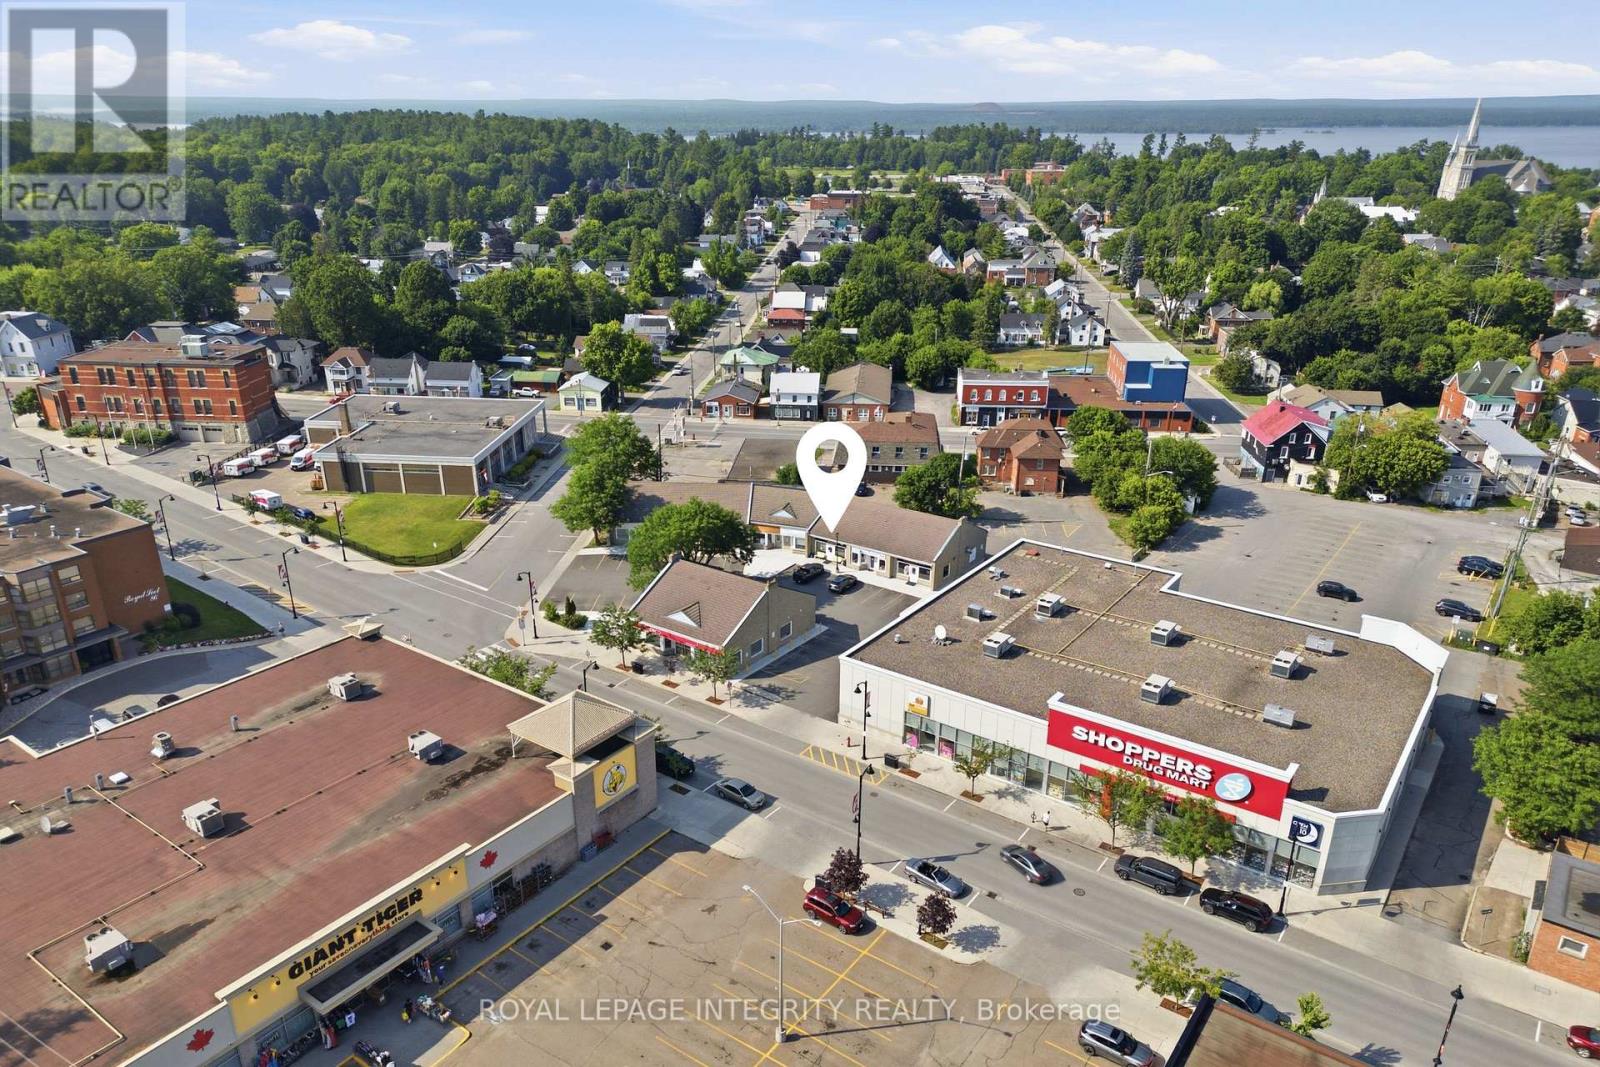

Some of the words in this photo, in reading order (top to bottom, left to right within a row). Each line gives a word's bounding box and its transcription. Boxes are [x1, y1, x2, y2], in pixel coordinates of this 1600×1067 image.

[1072, 725, 1213, 780] SHOPPERS
[1122, 755, 1164, 774] DRUG
[1166, 770, 1210, 790] MART
[288, 926, 357, 979] GIANT
[363, 888, 423, 932] TIGER
[391, 911, 409, 925] store
